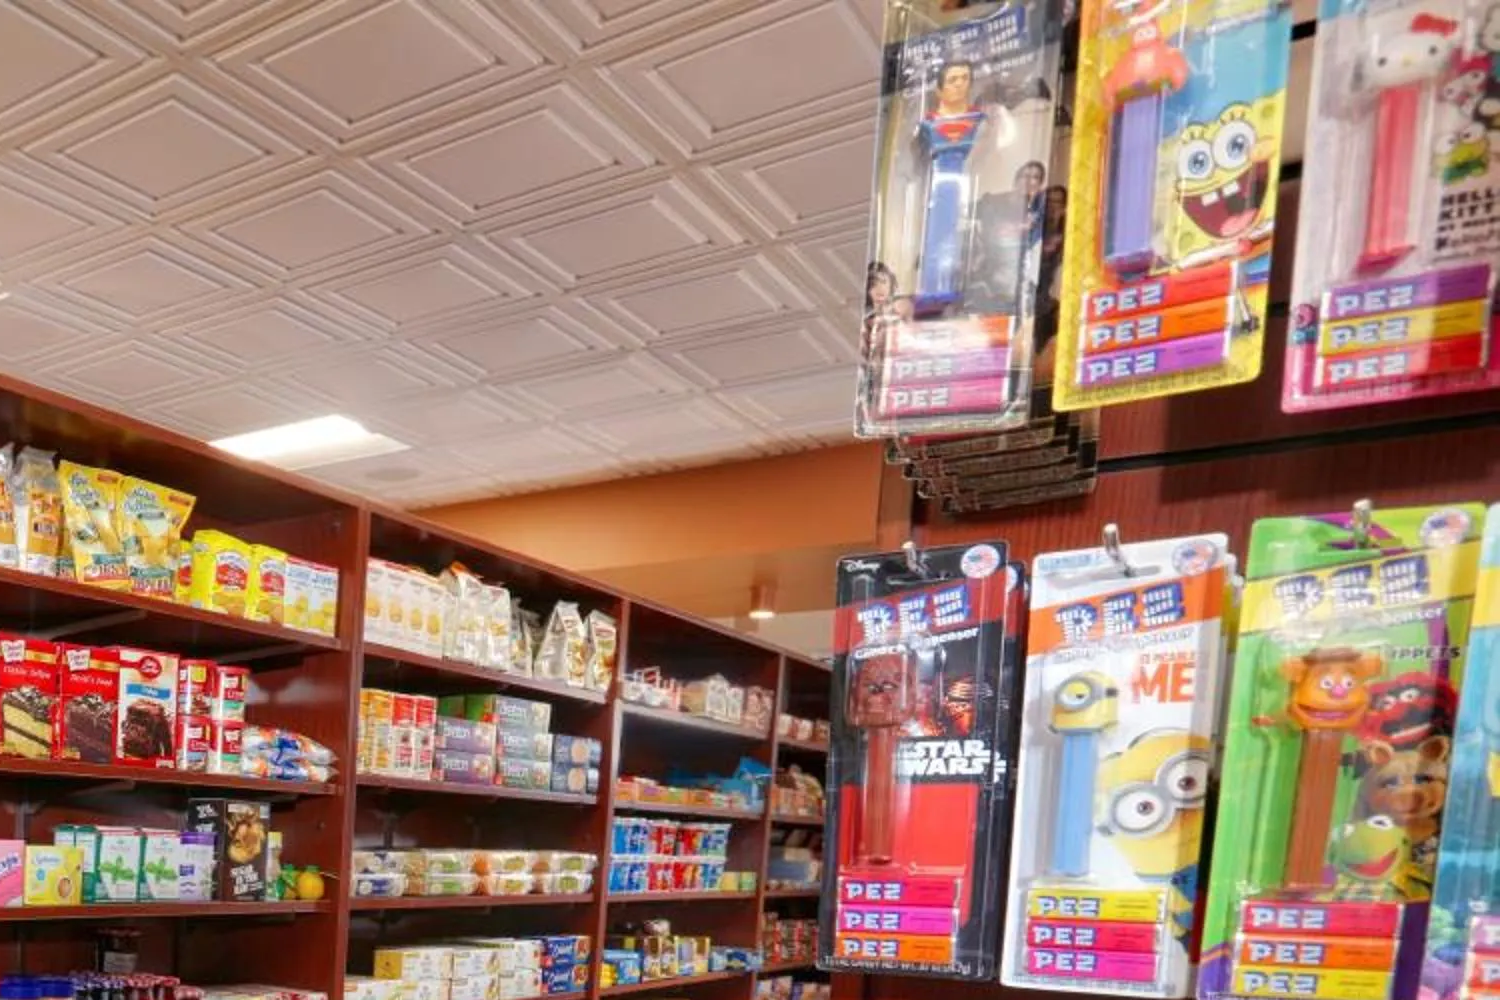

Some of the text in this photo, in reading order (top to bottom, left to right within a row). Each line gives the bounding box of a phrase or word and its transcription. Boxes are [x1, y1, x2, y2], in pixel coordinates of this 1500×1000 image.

[1441, 187, 1500, 206] HELL
[1439, 203, 1498, 222] KITT
[1092, 282, 1163, 316] PEZ
[1336, 285, 1414, 315] PEZ
[1090, 315, 1163, 346] PEZ
[1330, 318, 1409, 348] PEZ
[895, 357, 951, 378] PEZ
[1086, 352, 1158, 383] PEZ
[1328, 352, 1409, 383] PEZ
[891, 387, 950, 409] PEZ
[1274, 555, 1429, 620] PEZ
[857, 584, 972, 643] PEZ
[1055, 581, 1186, 645] PEZ
[1131, 661, 1197, 704] ME
[901, 739, 991, 758] STAR
[898, 757, 991, 776] WARS
[845, 881, 902, 901] PEZ
[1037, 895, 1100, 917] PEZ
[843, 909, 902, 931] PEZ
[1252, 906, 1328, 930] PEZ
[1033, 924, 1098, 946] PEZ
[841, 938, 899, 959] PEZ
[1250, 942, 1327, 964] PEZ
[1032, 951, 1098, 974] PEZ
[1243, 970, 1319, 994] PEZ
